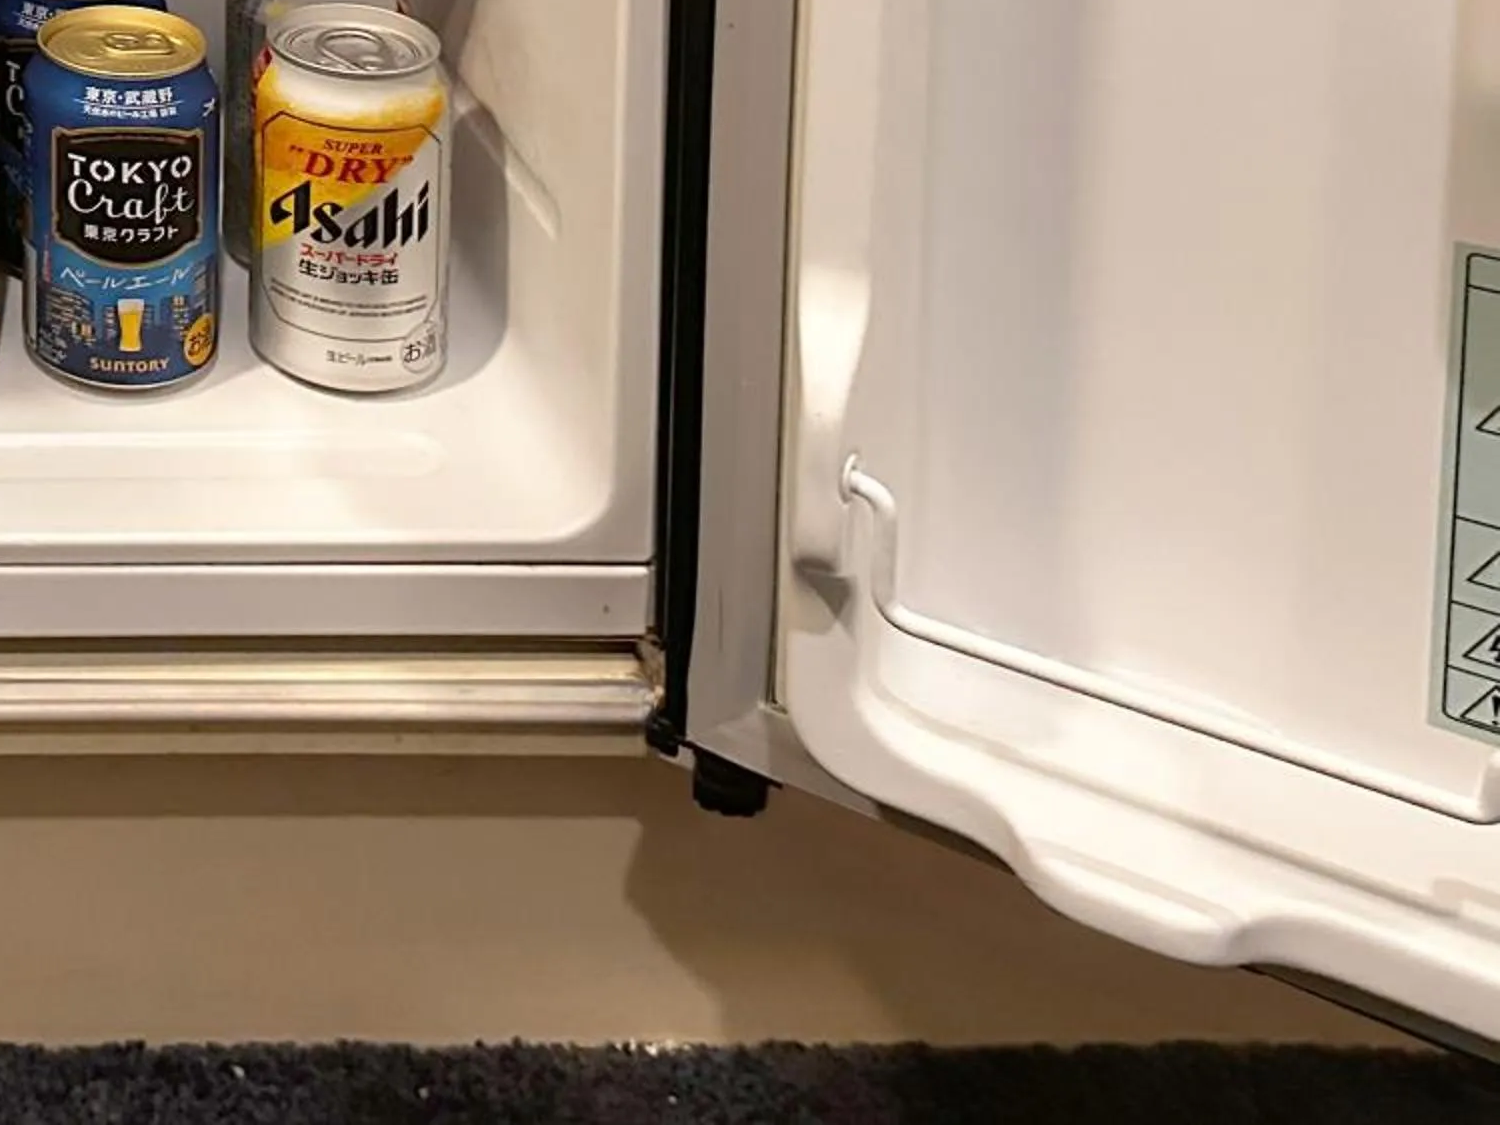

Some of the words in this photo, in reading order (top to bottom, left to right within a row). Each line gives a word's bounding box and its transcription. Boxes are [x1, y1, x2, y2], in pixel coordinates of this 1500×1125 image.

[323, 138, 384, 155] SUPER
[67, 152, 193, 184] TOKYO
[67, 178, 196, 226] Craft
[269, 180, 430, 250] Asahi
[83, 225, 179, 244] 東京クラフト
[300, 242, 398, 266] スーパードライ
[60, 266, 192, 290] ペールエール
[299, 258, 398, 285] 生ジョッキ缶
[90, 357, 171, 374] SUNTORY
